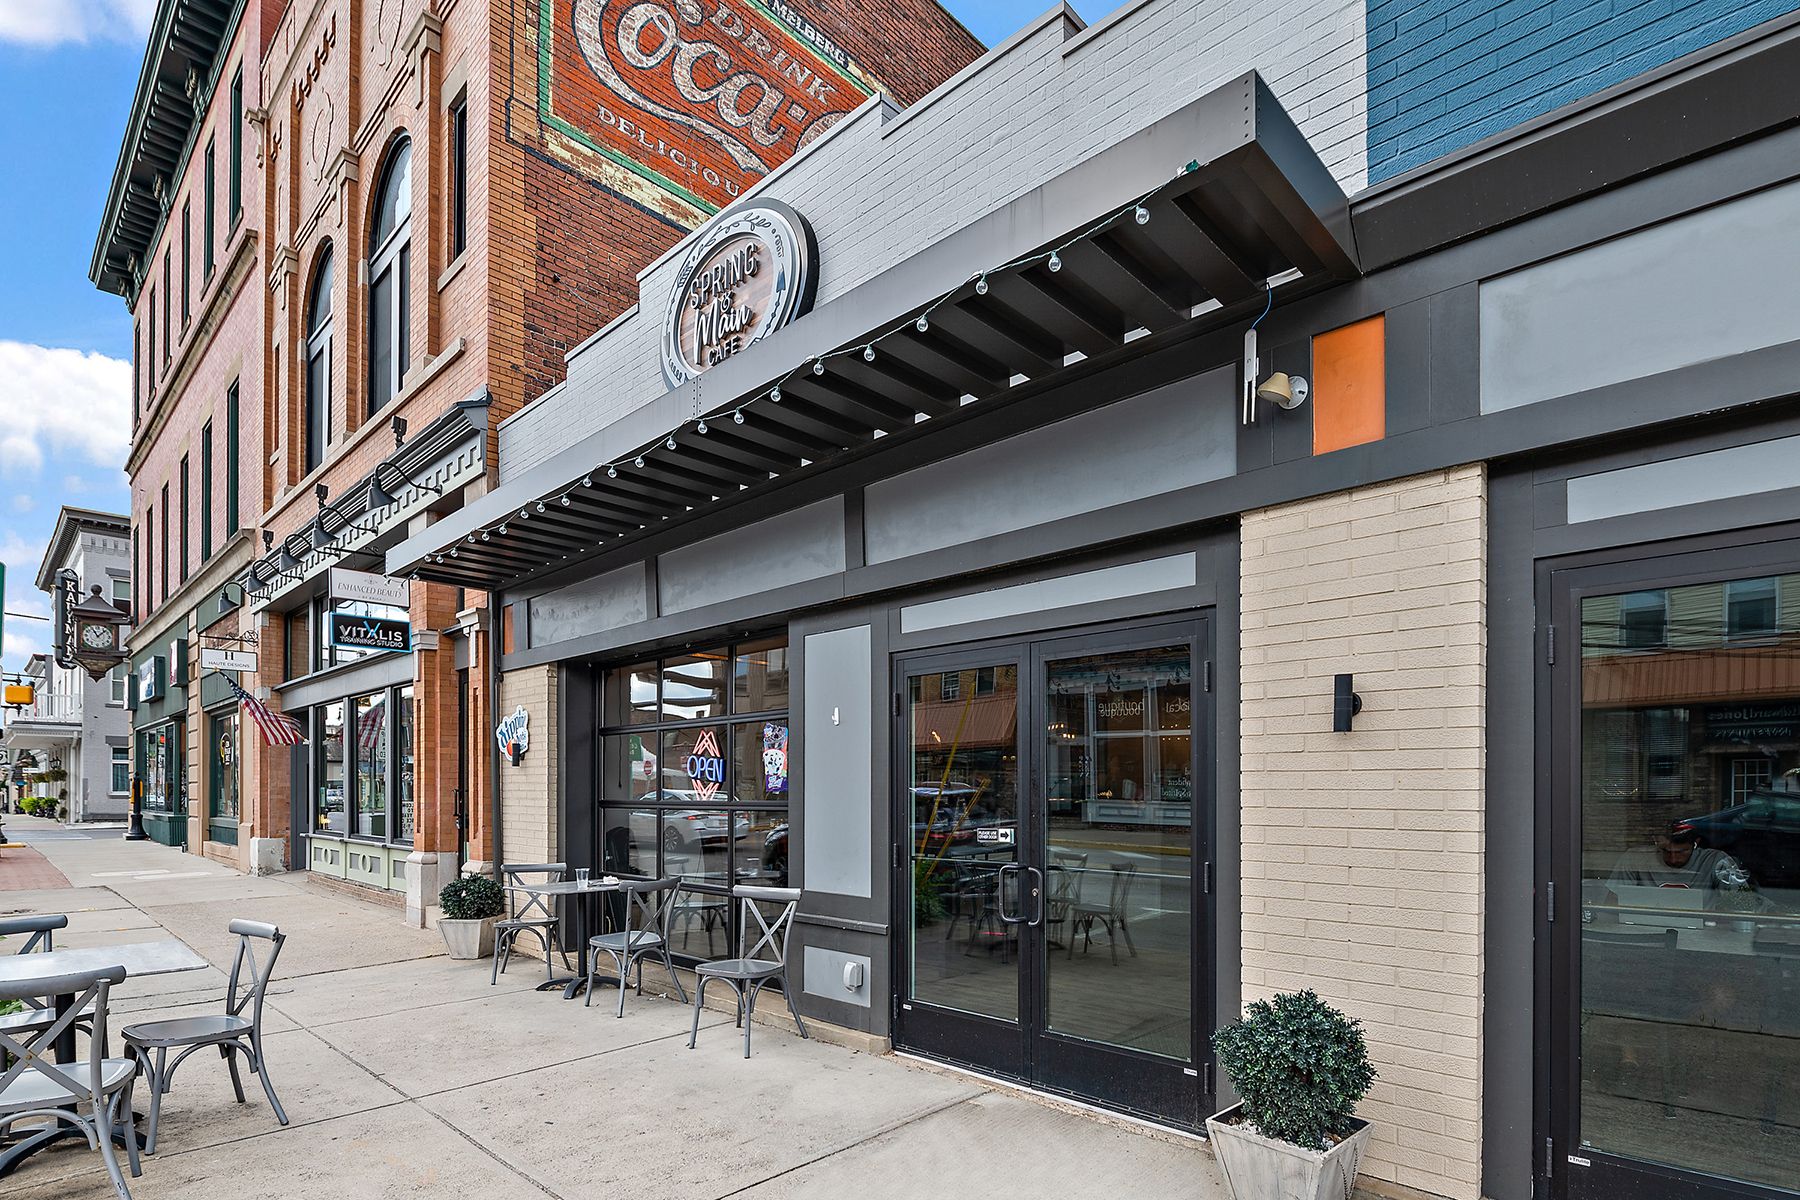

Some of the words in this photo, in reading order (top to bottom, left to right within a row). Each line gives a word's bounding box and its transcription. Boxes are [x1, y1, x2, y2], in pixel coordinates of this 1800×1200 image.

[709, 4, 838, 105] DRINK
[598, 104, 742, 197] DELICIOU
[689, 241, 760, 310] SPRING
[720, 291, 734, 315] &
[693, 297, 750, 366] Main
[707, 336, 741, 366] CAFE
[337, 582, 376, 595] ENHANCED
[376, 588, 403, 599] BEAUTY
[338, 620, 403, 642] VITALIS
[339, 635, 376, 646] TRAINING
[376, 639, 404, 648] STUDIO
[686, 754, 725, 783] OPEN
